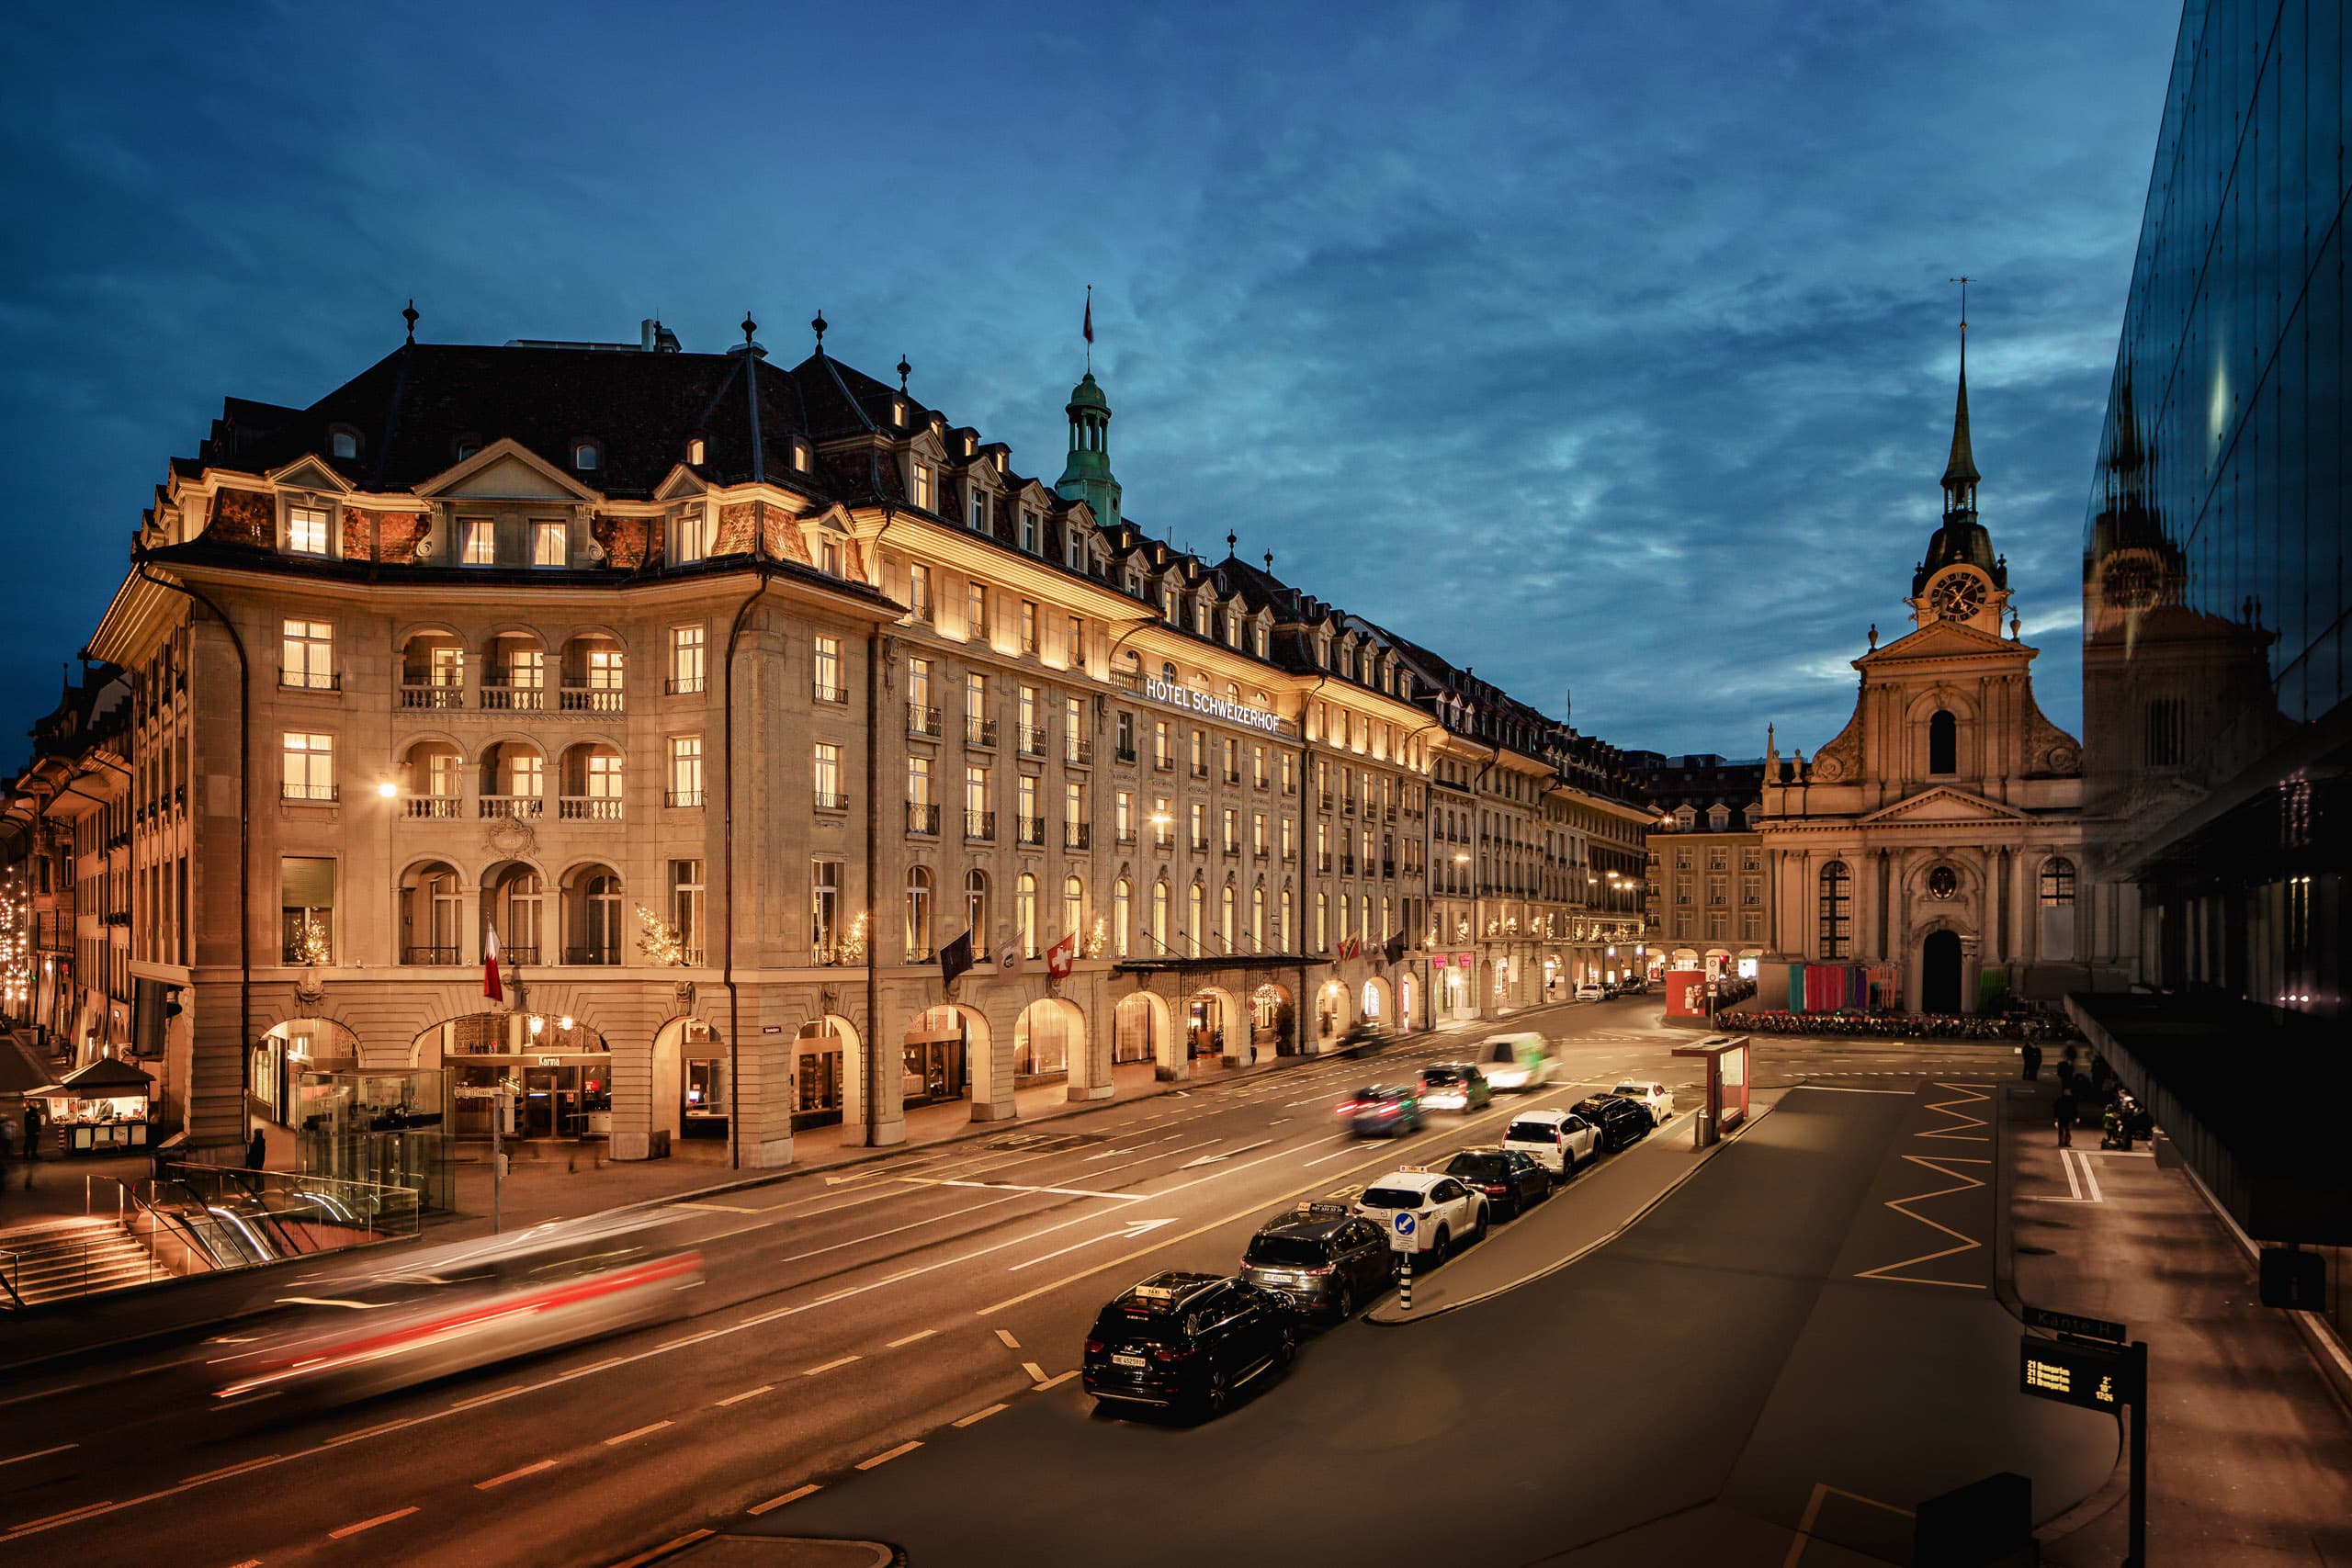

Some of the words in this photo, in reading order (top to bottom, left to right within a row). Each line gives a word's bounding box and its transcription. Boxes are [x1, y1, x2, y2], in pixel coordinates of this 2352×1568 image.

[1146, 678, 1191, 707] HOTEL
[1193, 692, 1280, 732] SCHWEIZERHOF
[538, 1056, 560, 1066] Karma
[2027, 1359, 2036, 1369] 21
[2027, 1368, 2036, 1377] 21
[2027, 1376, 2036, 1384] 21
